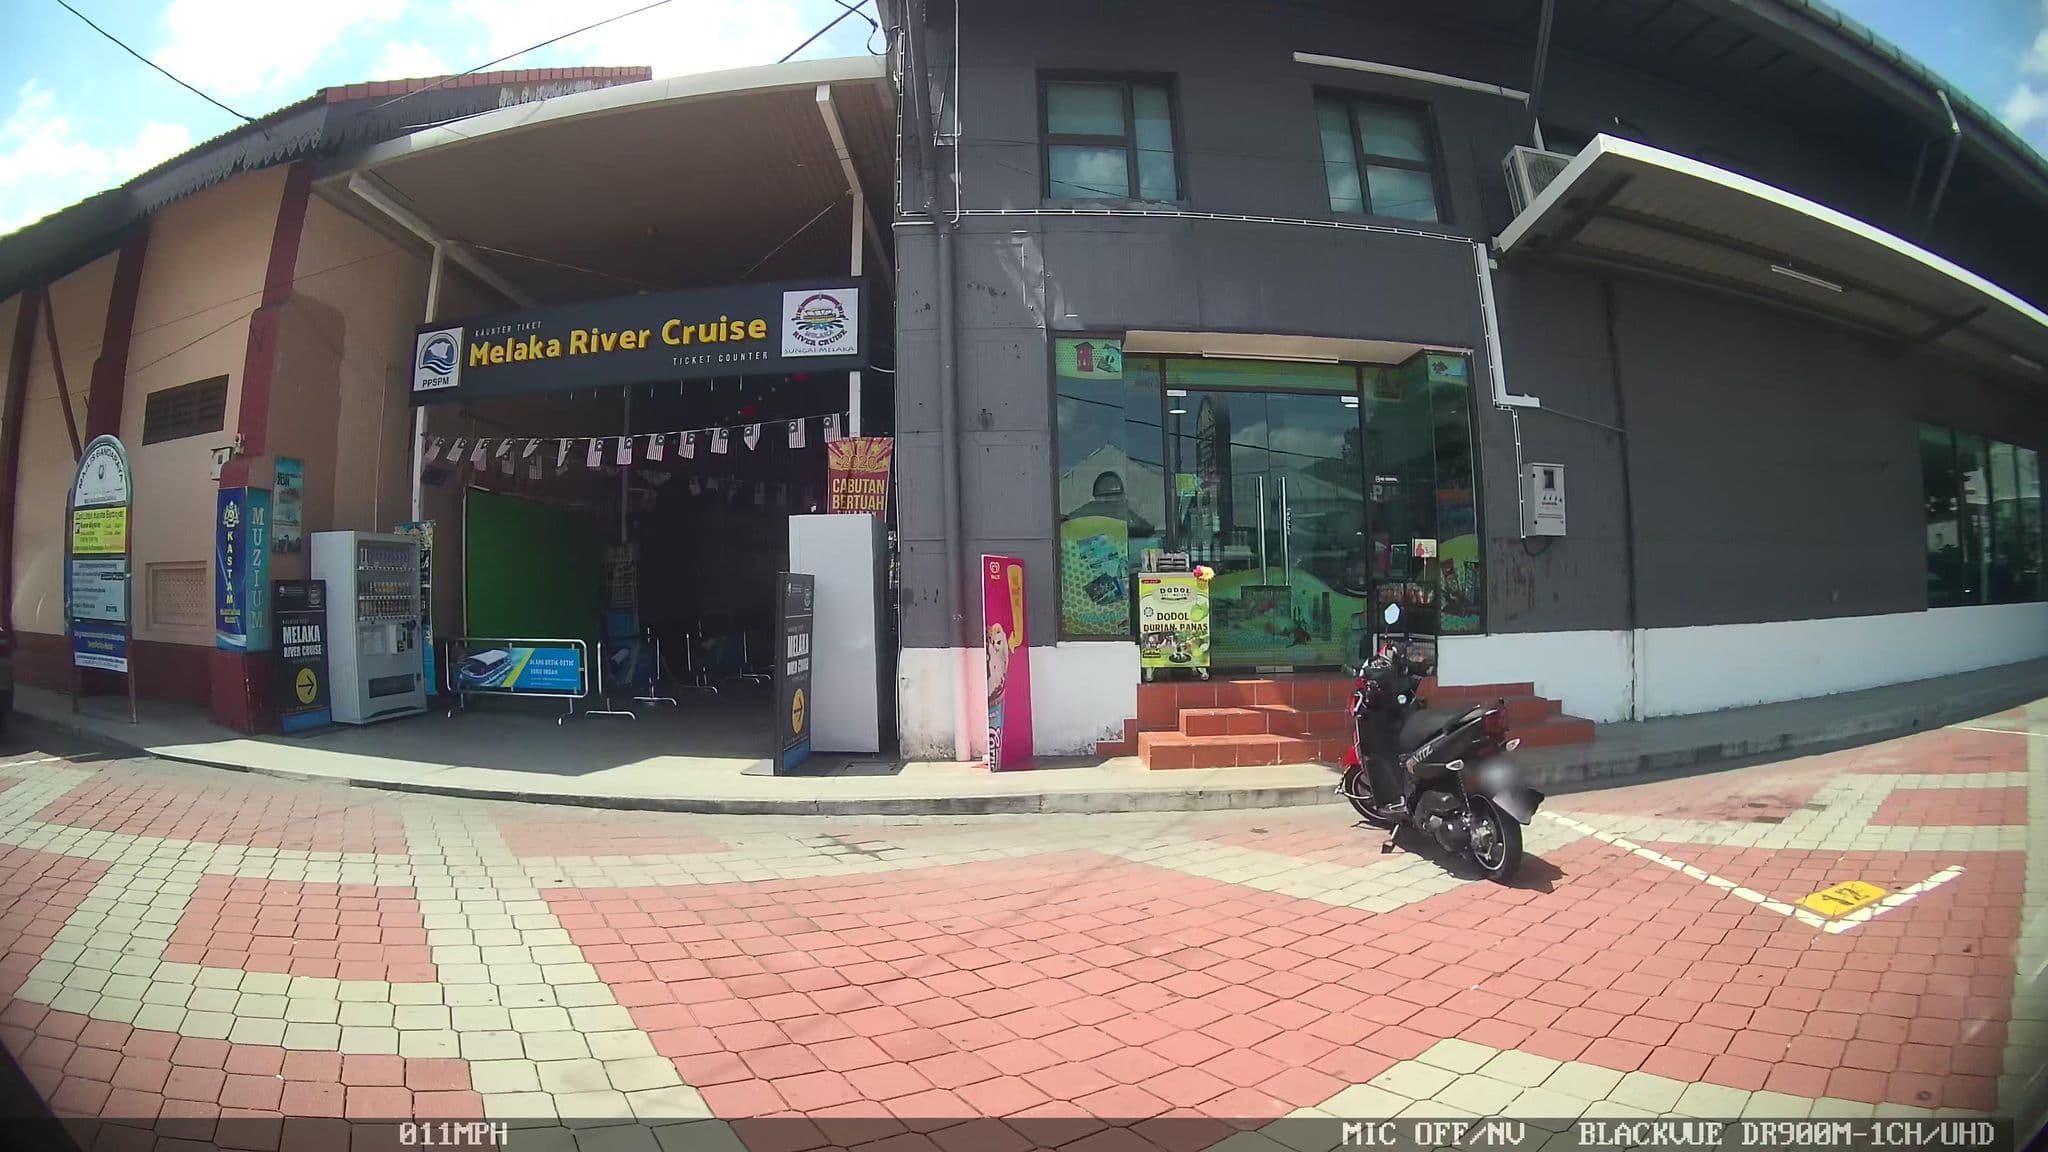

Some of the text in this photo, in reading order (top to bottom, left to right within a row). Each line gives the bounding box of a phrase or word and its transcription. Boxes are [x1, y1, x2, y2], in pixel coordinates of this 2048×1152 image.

[475, 320, 542, 337] KAUNTER TIKET
[469, 315, 768, 367] Melaka River Cruise
[792, 329, 848, 346] RIVER CRUISE
[672, 351, 769, 366] TICKET COUNTER
[422, 376, 450, 388] PPSPM
[841, 455, 877, 470] 2020
[832, 478, 885, 494] CABUTAN
[832, 494, 885, 511] BERTUAH
[226, 531, 234, 604] KASTAM
[251, 506, 265, 629] MUZIUM
[1157, 612, 1190, 621] DODOL
[283, 624, 321, 644] MELAKA
[1180, 623, 1208, 632] PANAS
[284, 644, 322, 658] RIVER CRUISE
